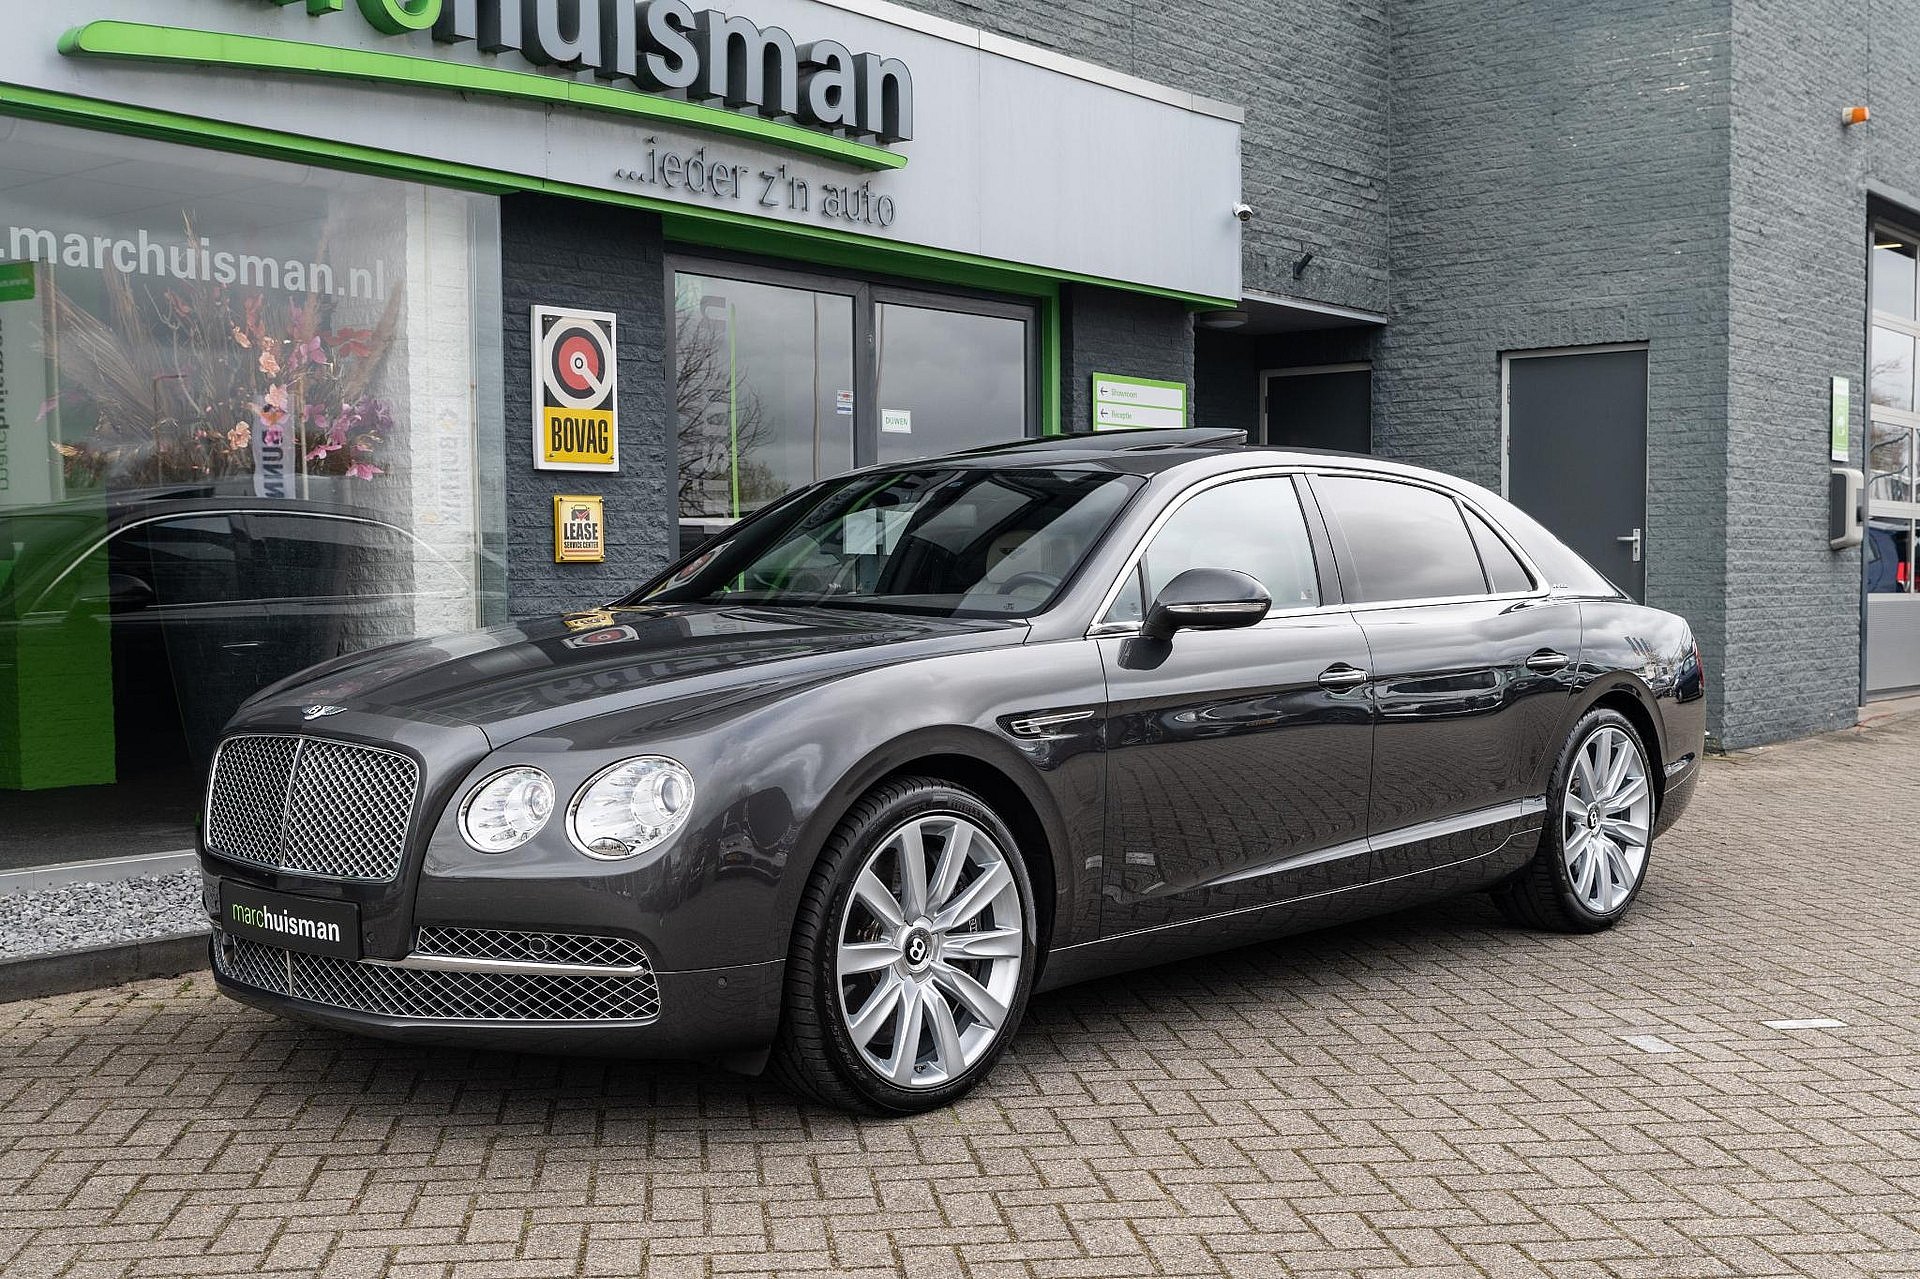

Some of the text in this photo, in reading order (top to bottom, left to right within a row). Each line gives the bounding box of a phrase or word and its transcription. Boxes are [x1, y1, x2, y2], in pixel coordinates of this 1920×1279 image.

[758, 164, 812, 213] z'n
[822, 180, 897, 229] auto
[551, 416, 609, 455] BOVAG
[563, 522, 598, 541] LEASE
[563, 541, 599, 549] SERVICE CENTER
[231, 901, 341, 943] marchuisman
